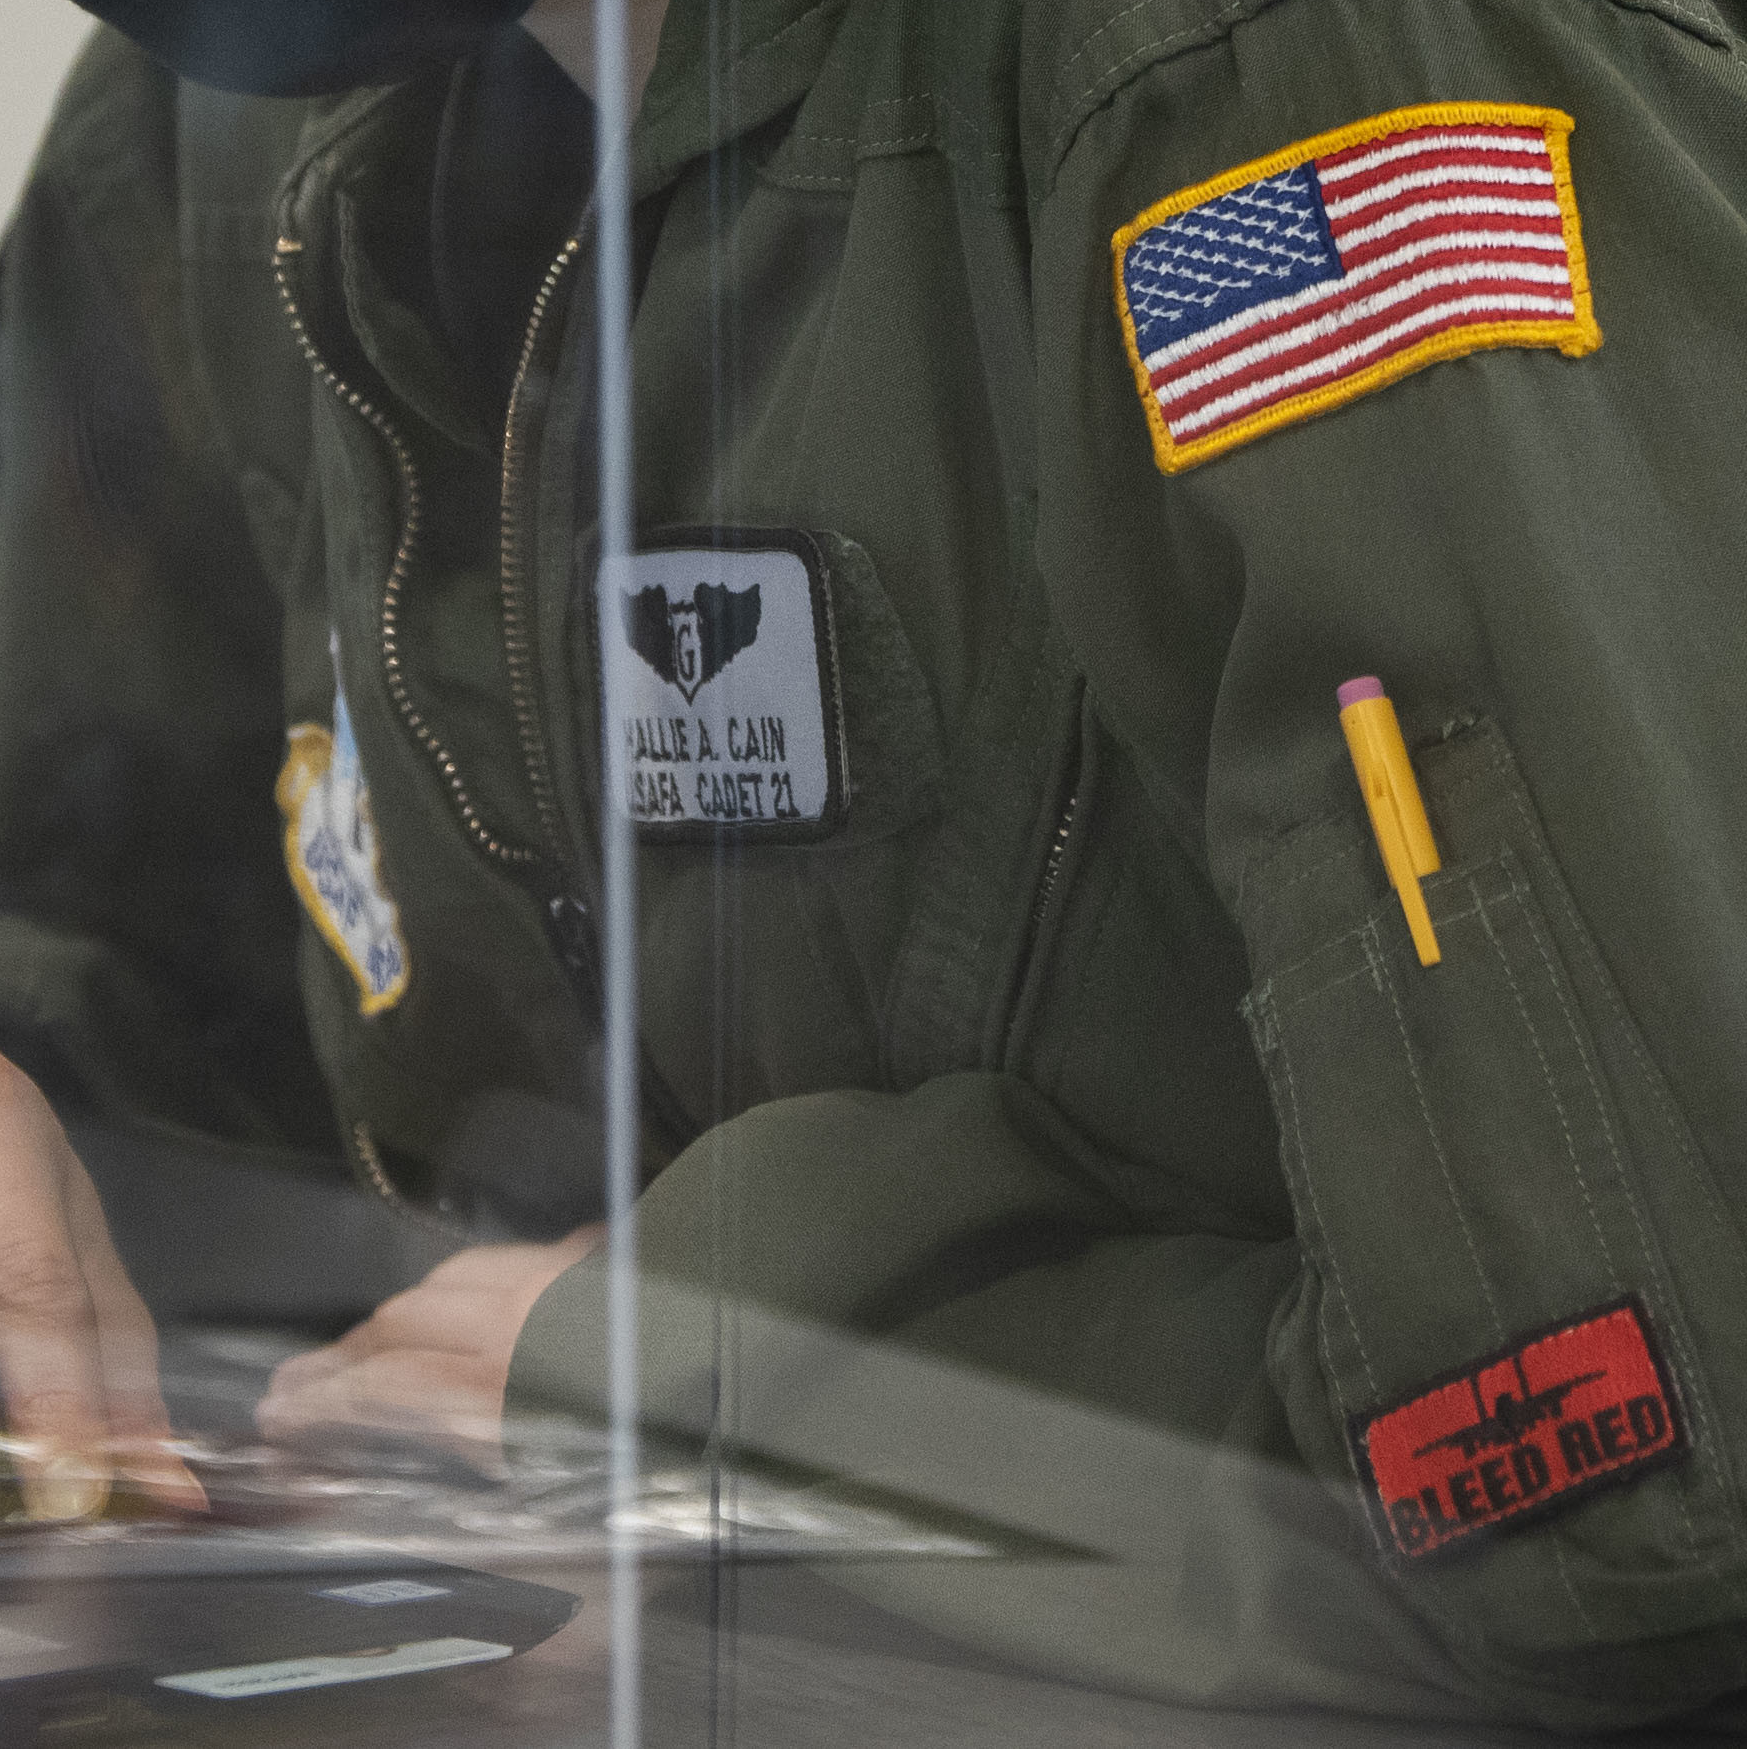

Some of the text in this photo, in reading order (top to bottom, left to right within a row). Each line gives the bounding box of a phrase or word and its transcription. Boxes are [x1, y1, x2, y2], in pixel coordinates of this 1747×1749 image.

[727, 716, 786, 764] CAIN
[626, 770, 801, 818] SAFA CADET 21
[1390, 1395, 1670, 1551] BLEED RED
